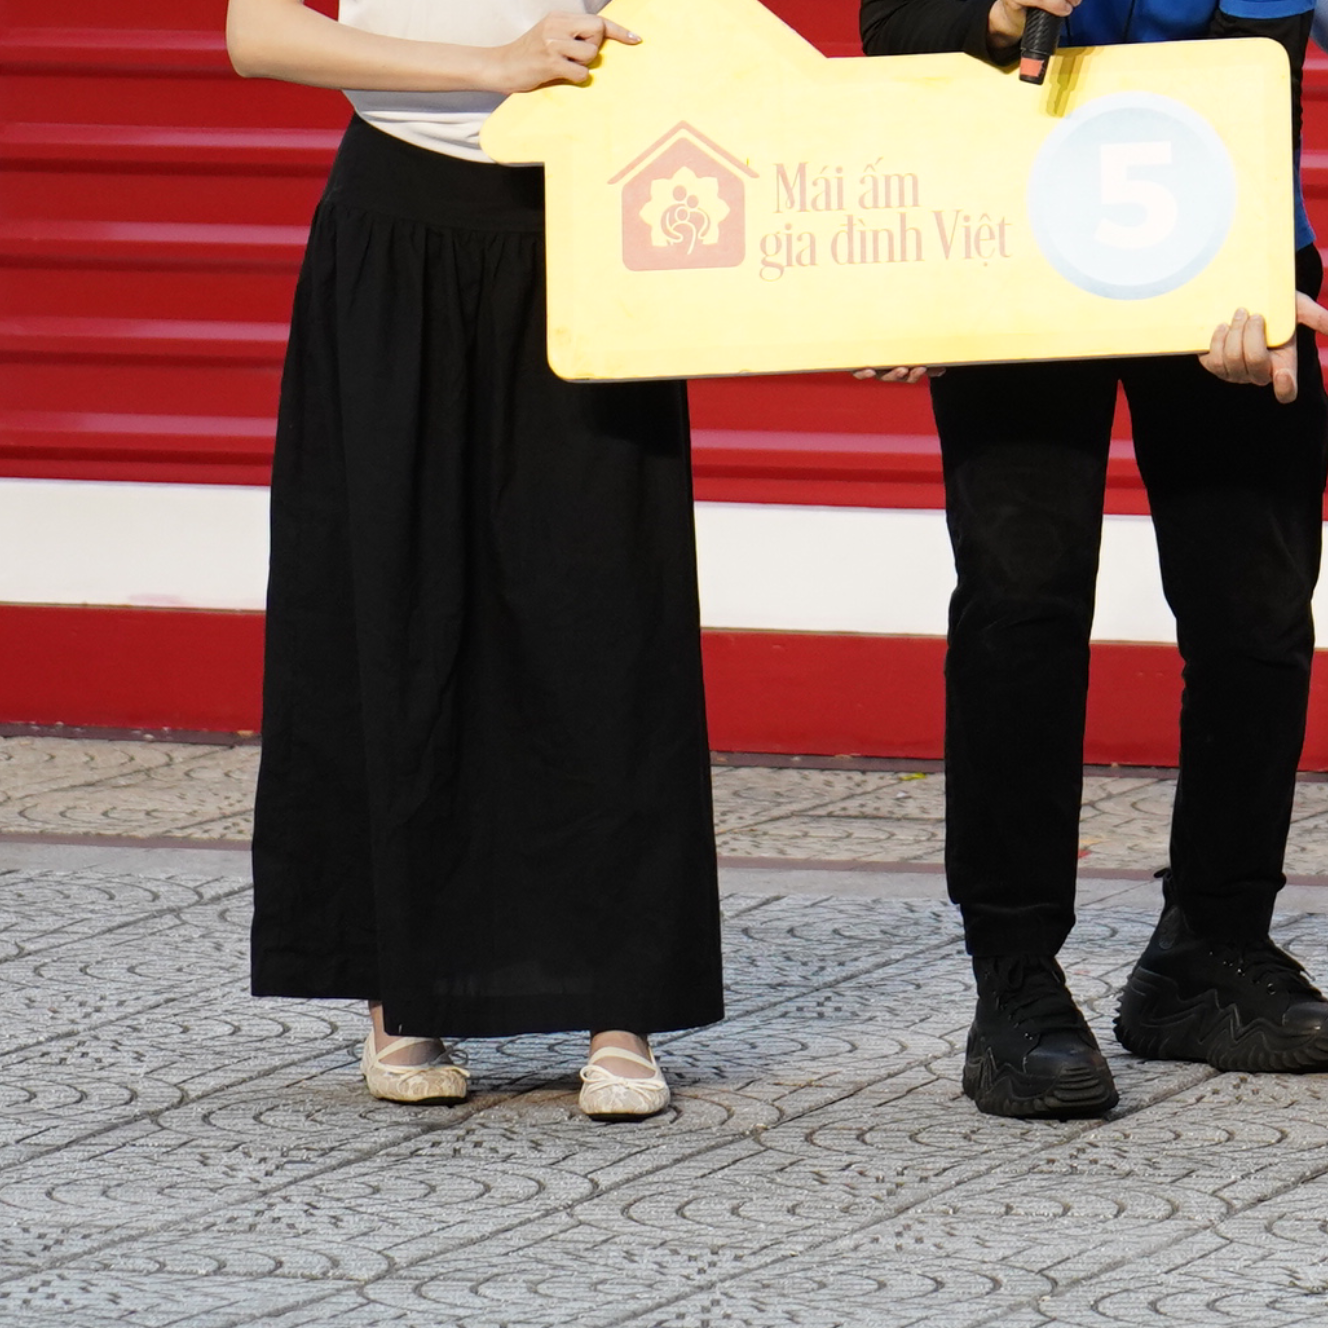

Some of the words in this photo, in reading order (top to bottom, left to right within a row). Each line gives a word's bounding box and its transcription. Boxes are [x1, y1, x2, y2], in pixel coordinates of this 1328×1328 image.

[773, 161, 847, 213] Mái
[857, 156, 922, 210] ấm
[1093, 140, 1179, 250] 5
[758, 222, 819, 283] gia
[830, 211, 926, 266] đình
[931, 209, 1014, 268] Việt
